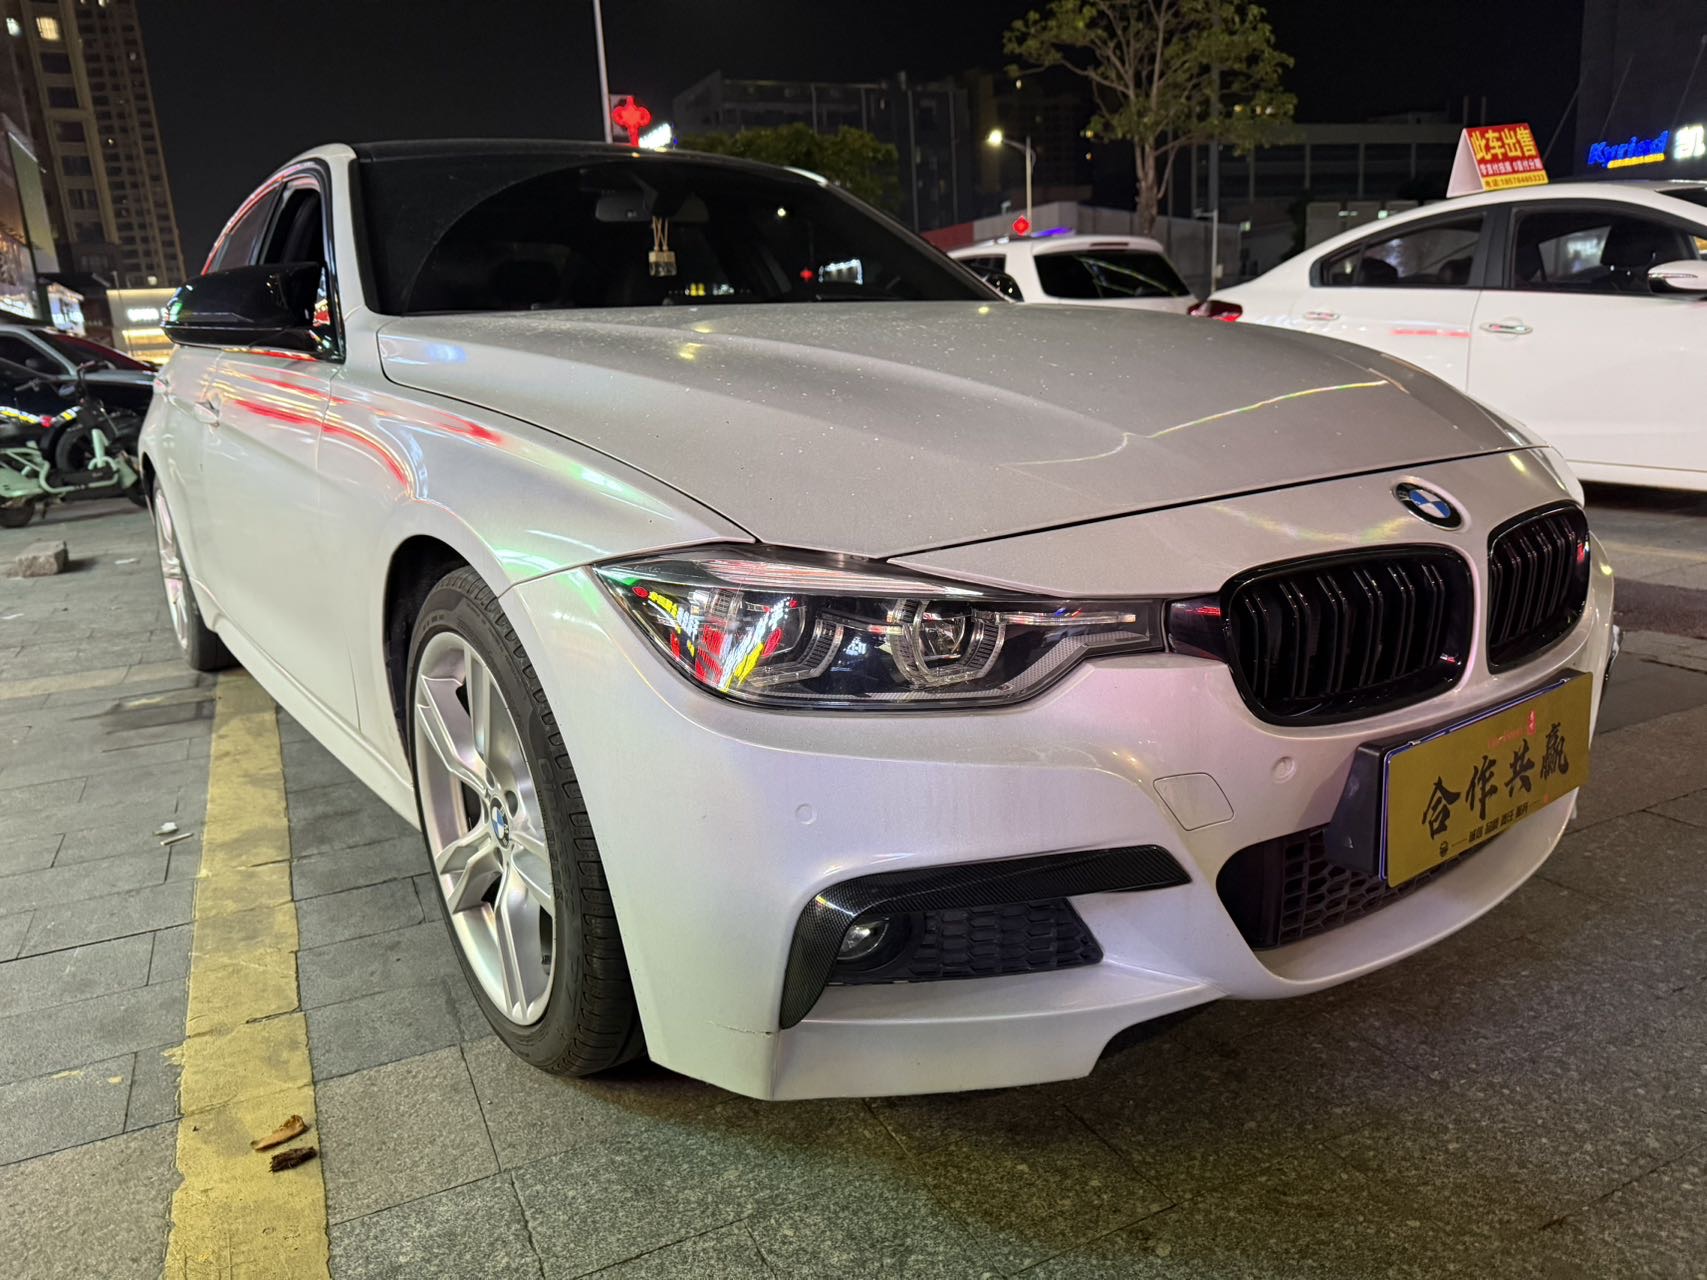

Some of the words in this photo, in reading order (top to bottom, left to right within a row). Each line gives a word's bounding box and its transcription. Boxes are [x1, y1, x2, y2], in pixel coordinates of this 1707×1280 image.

[1471, 126, 1537, 160] 此车出售
[1421, 722, 1569, 840] 合作共赢
